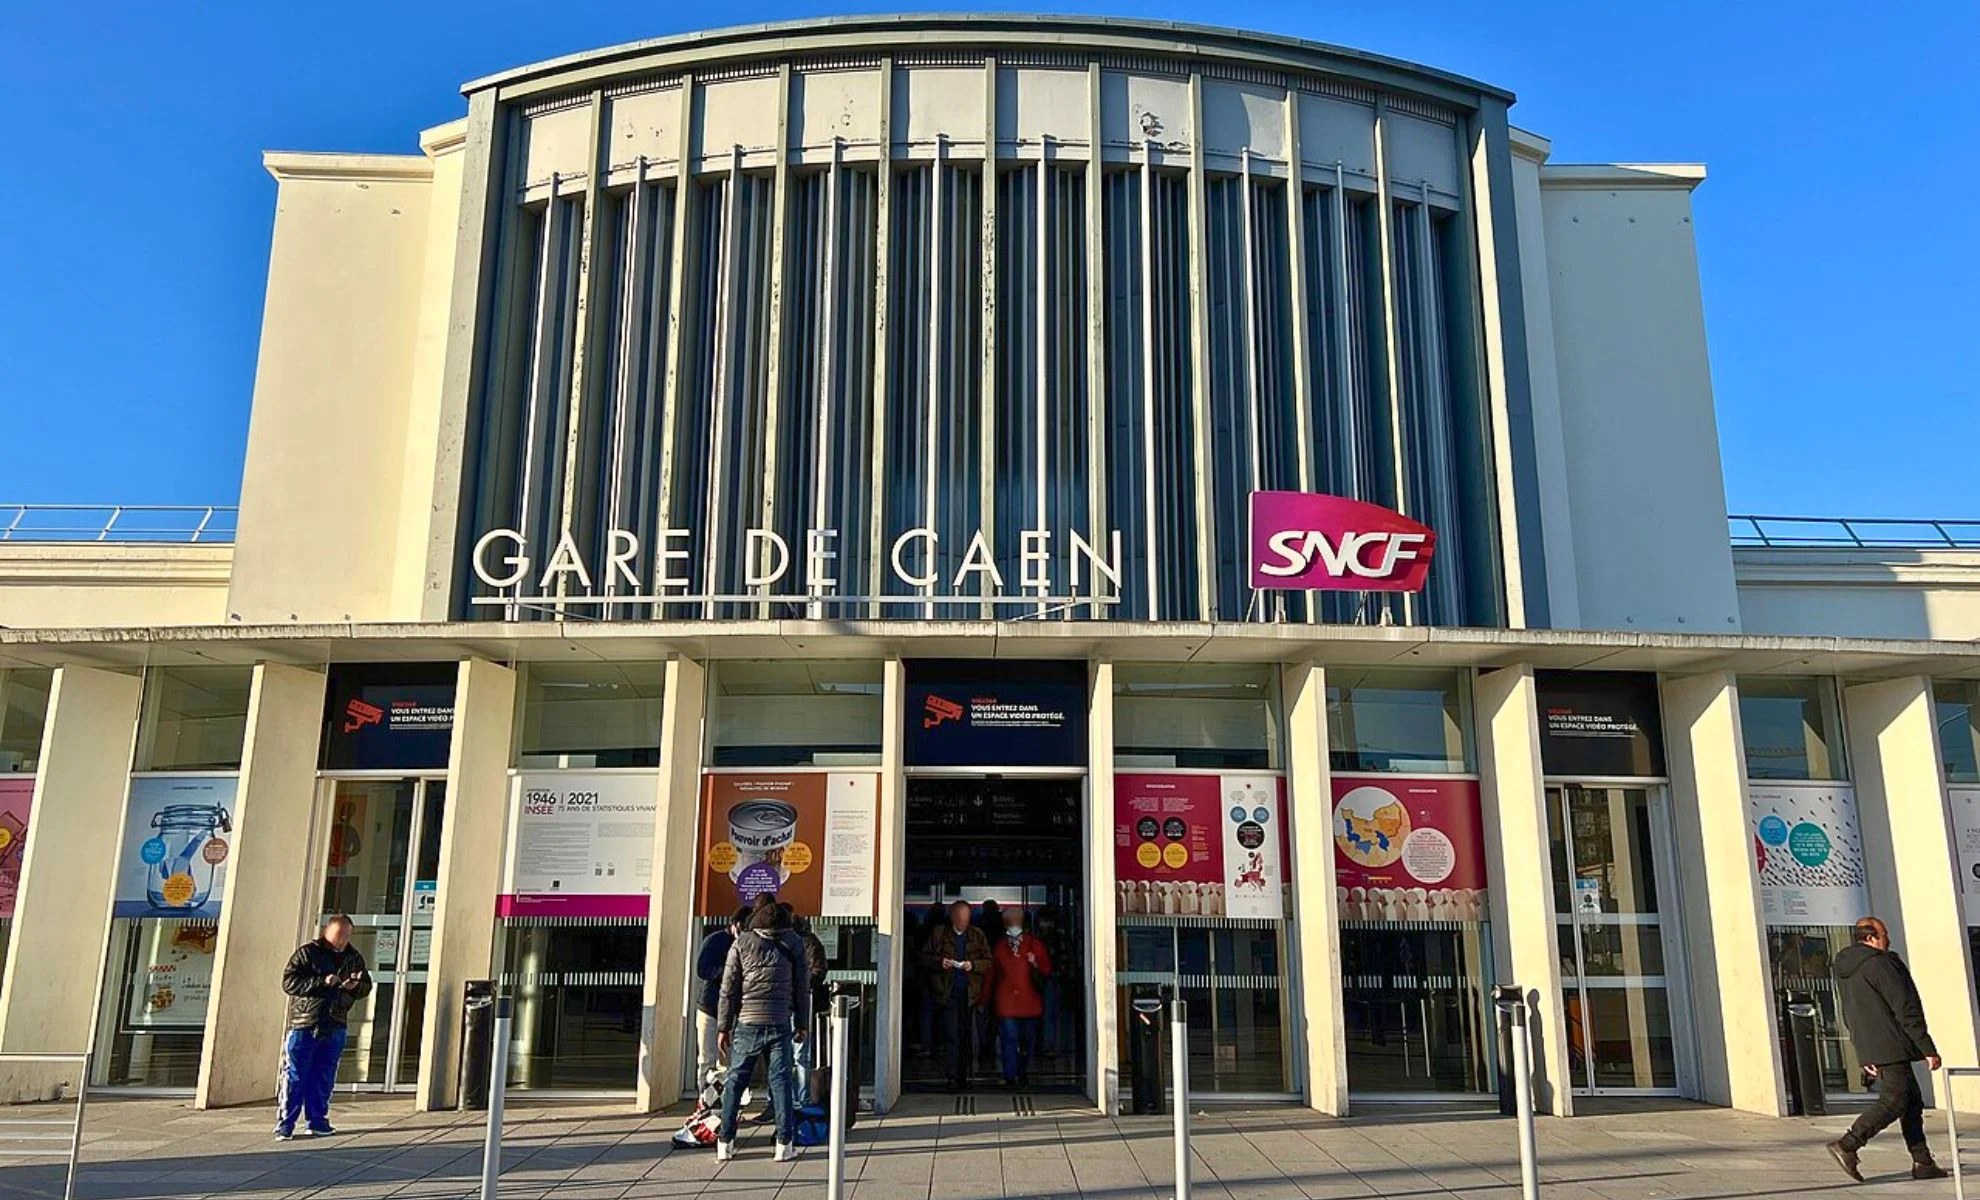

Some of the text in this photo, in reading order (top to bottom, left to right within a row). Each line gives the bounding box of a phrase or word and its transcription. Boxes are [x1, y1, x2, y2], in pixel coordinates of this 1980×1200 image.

[472, 528, 1122, 588] GARE DE CAEN
[1259, 530, 1426, 578] SNCF
[1560, 722, 1585, 730] ESPACE
[526, 792, 556, 804] 1946
[567, 792, 598, 805] 2021
[524, 805, 554, 815] INSEE
